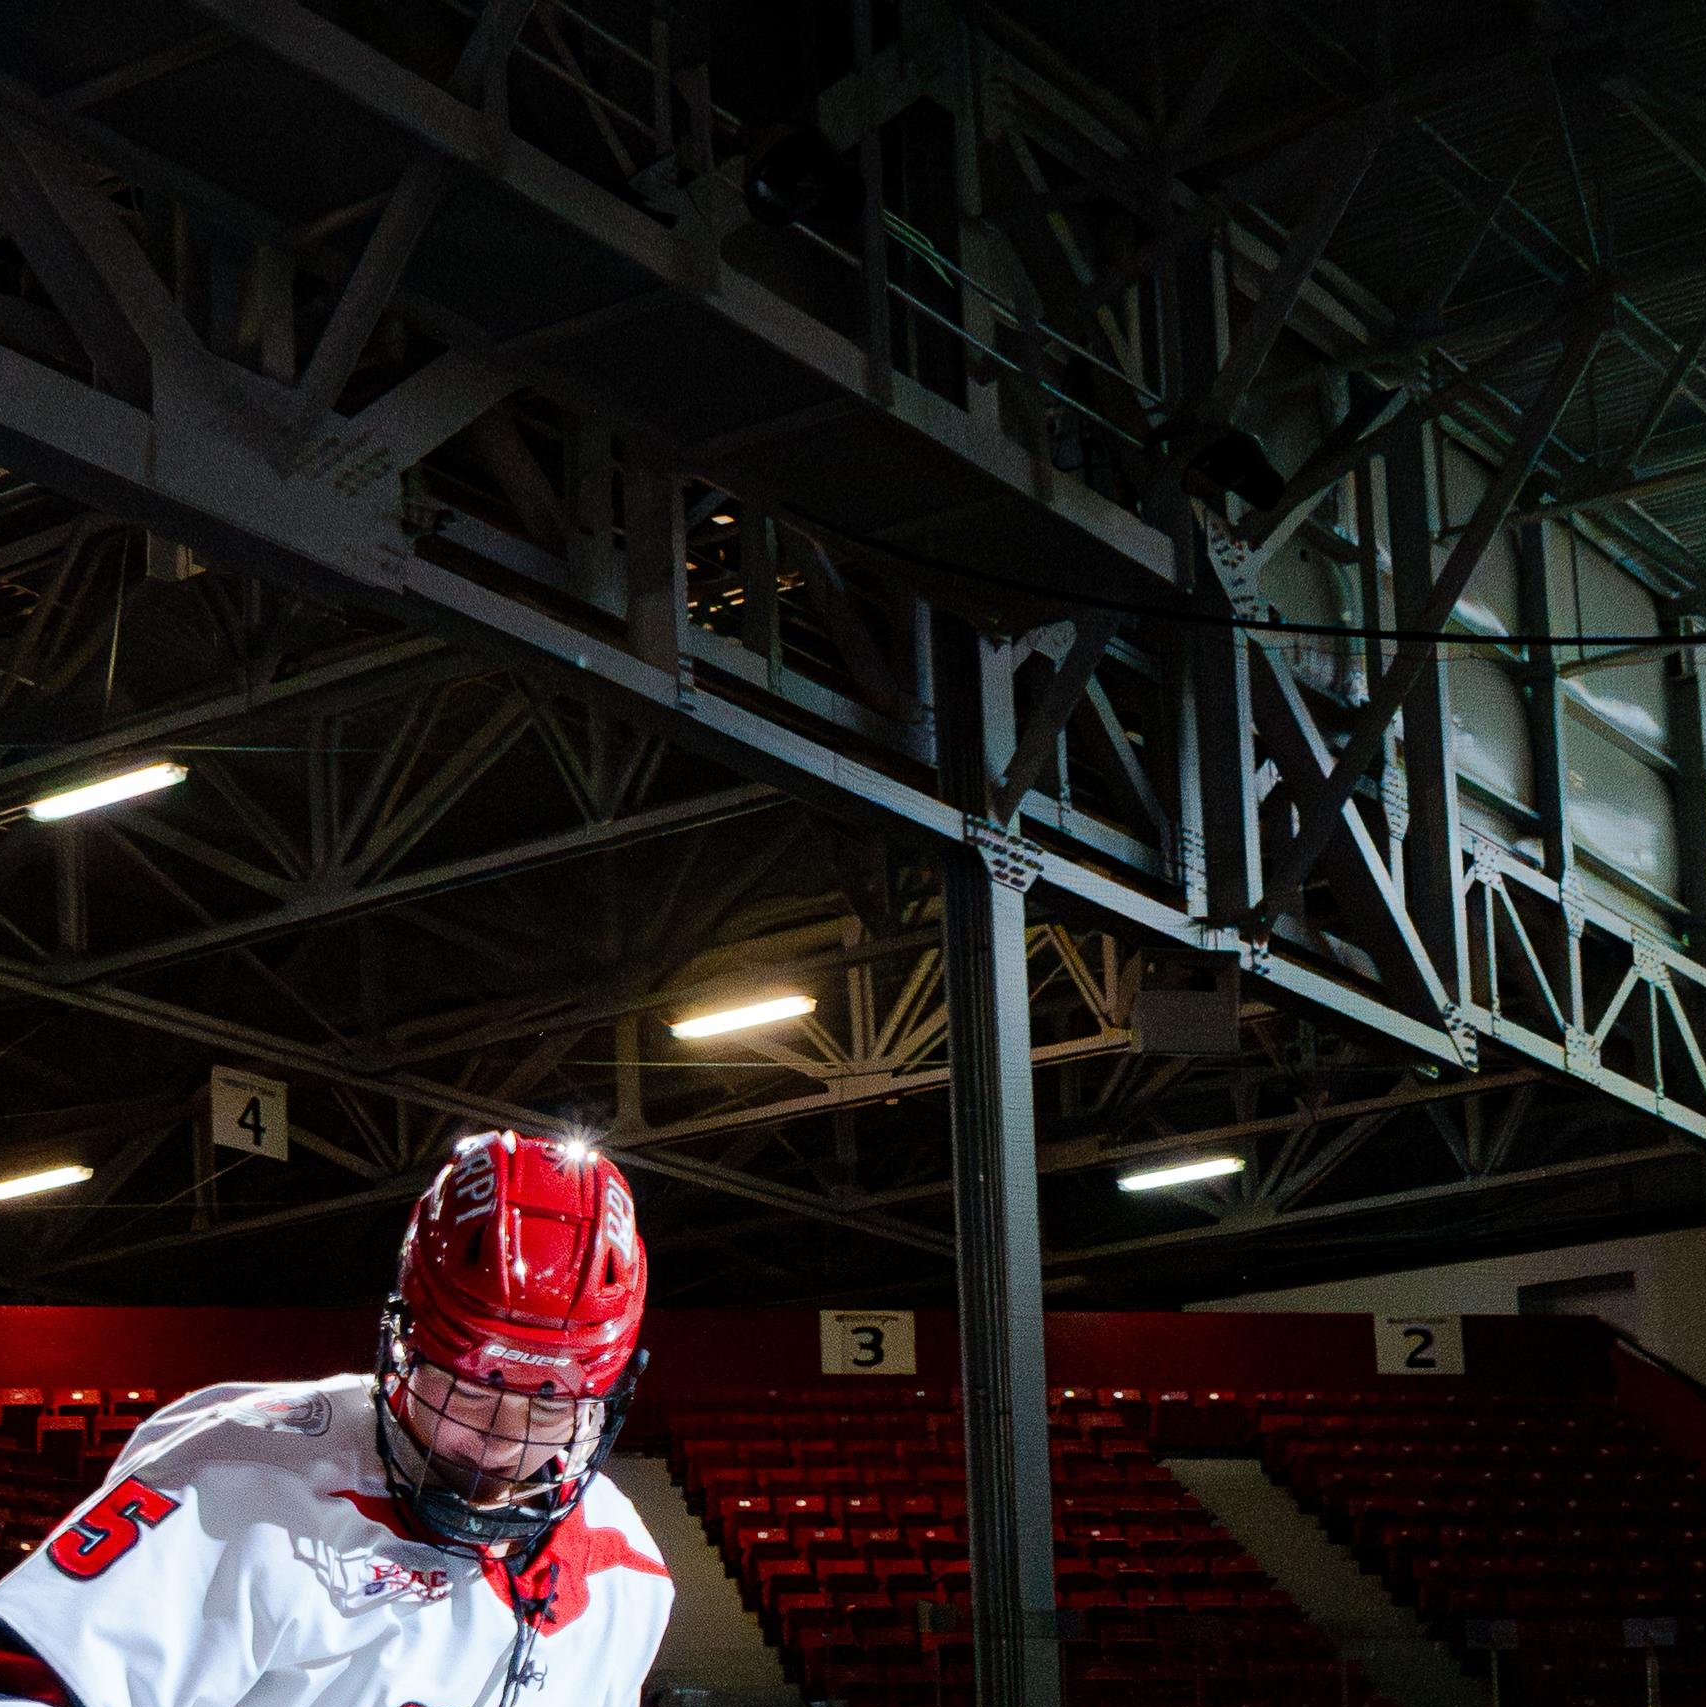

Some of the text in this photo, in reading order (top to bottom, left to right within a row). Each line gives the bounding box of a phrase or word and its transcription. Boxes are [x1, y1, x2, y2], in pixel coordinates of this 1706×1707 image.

[237, 1096, 267, 1148] 4
[483, 1344, 572, 1368] BAUER
[850, 1326, 884, 1367] 3
[1403, 1329, 1436, 1368] 2
[46, 1474, 182, 1582] 5
